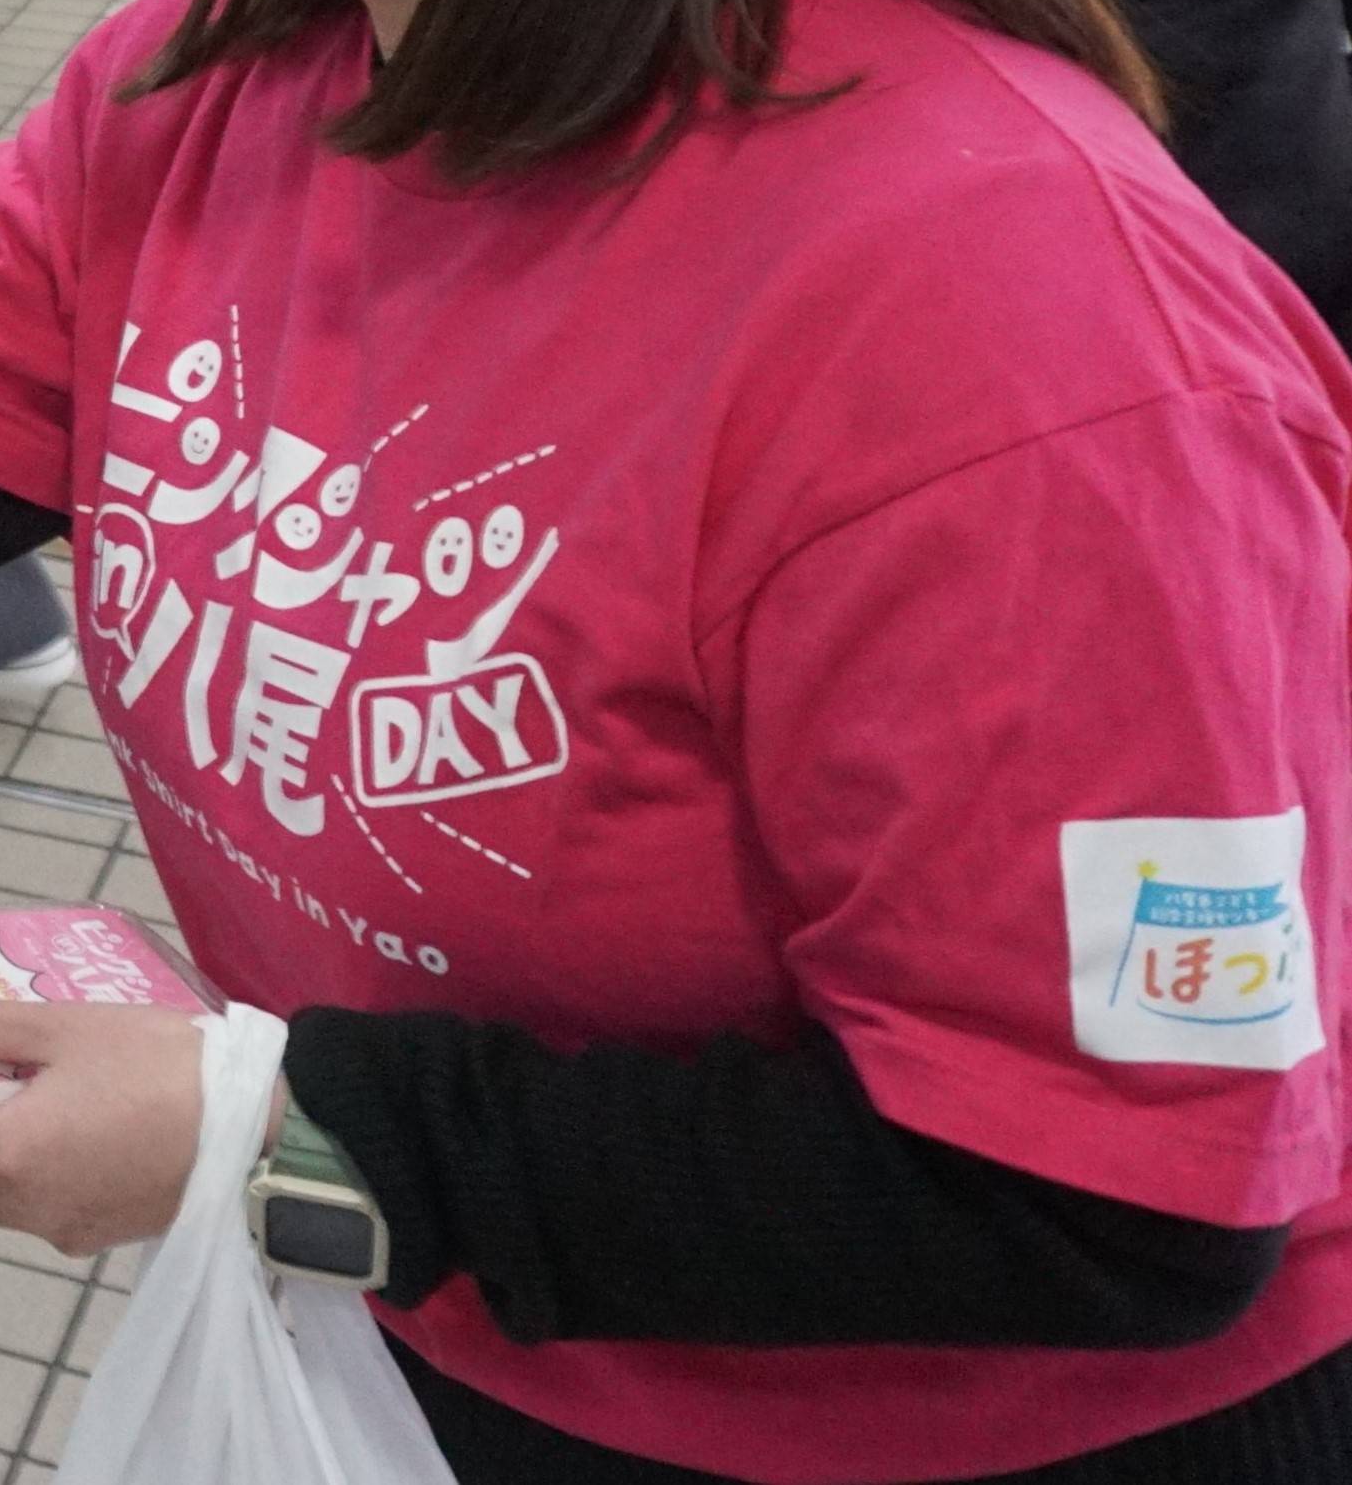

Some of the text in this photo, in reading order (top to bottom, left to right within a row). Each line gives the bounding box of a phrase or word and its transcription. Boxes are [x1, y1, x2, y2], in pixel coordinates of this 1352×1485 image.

[117, 577, 354, 837] 八尾
[372, 671, 533, 790] DAY
[291, 876, 331, 929] in
[337, 907, 449, 976] Yao
